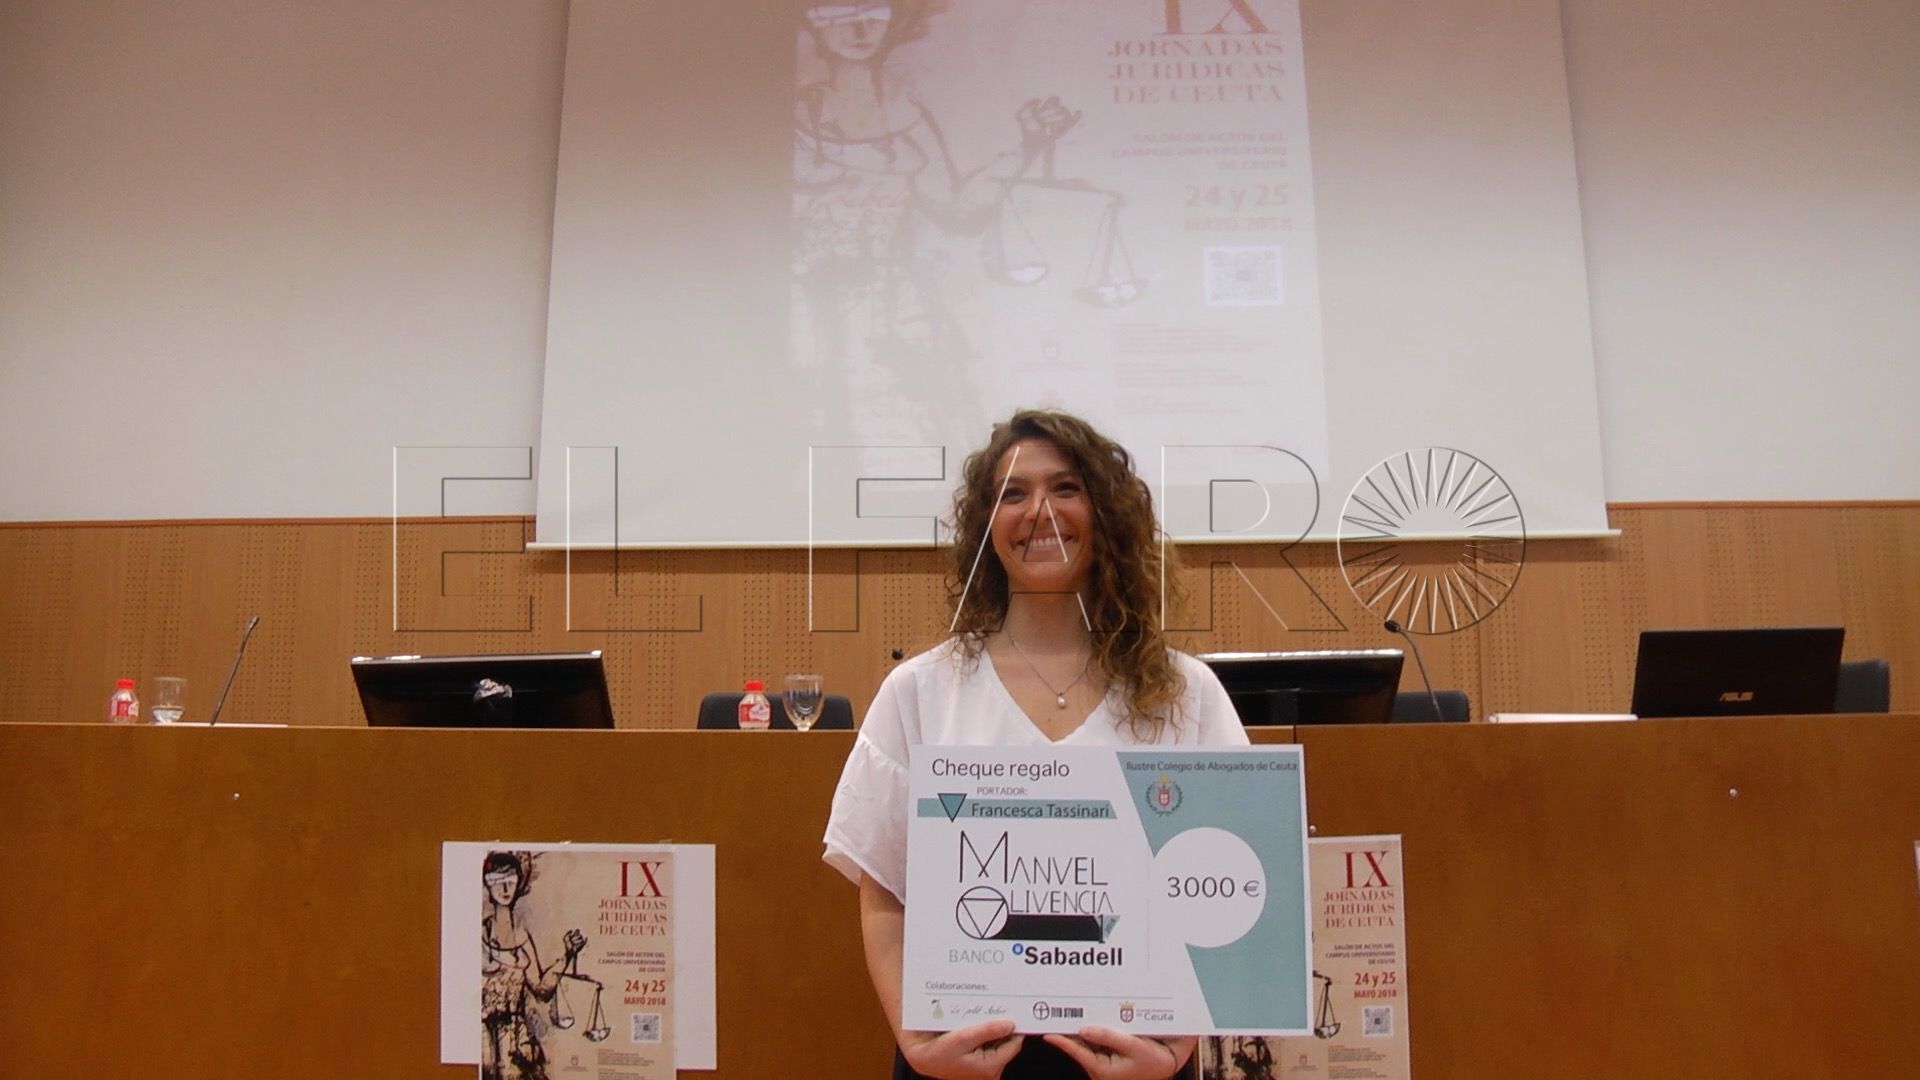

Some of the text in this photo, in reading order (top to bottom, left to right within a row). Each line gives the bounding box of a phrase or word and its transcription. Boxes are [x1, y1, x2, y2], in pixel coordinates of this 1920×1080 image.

[1153, 0, 1281, 35] IX
[1108, 39, 1283, 57] JORNADAS
[1113, 83, 1283, 103] DE CEUTA
[1184, 183, 1289, 212] 24 y 25
[932, 758, 1070, 782] Cheque regalo
[1157, 761, 1193, 774] Colegio
[1194, 761, 1205, 772] de
[1207, 761, 1255, 774] Abogados
[1256, 761, 1268, 772] de
[1269, 761, 1298, 772] Ceuta
[976, 786, 1029, 797] PORTADOR:
[971, 803, 1110, 819] Francesca Tassinari
[1340, 850, 1394, 889] IX
[616, 861, 667, 897] IX
[1167, 876, 1260, 898] 3000 €
[598, 898, 667, 910] JORNADAS
[1324, 890, 1394, 902] JORNADAS
[600, 924, 666, 936] DE CEUTA
[1326, 916, 1394, 929] DE CEUTA
[949, 945, 1123, 967] BANCO Sabadell
[625, 980, 666, 995] 24 y 25
[925, 980, 989, 992] Colaboraciones:
[1355, 971, 1396, 988] 24 y 25
[624, 996, 666, 1006] MAYO 2018
[1354, 989, 1397, 999] MAYO 2018
